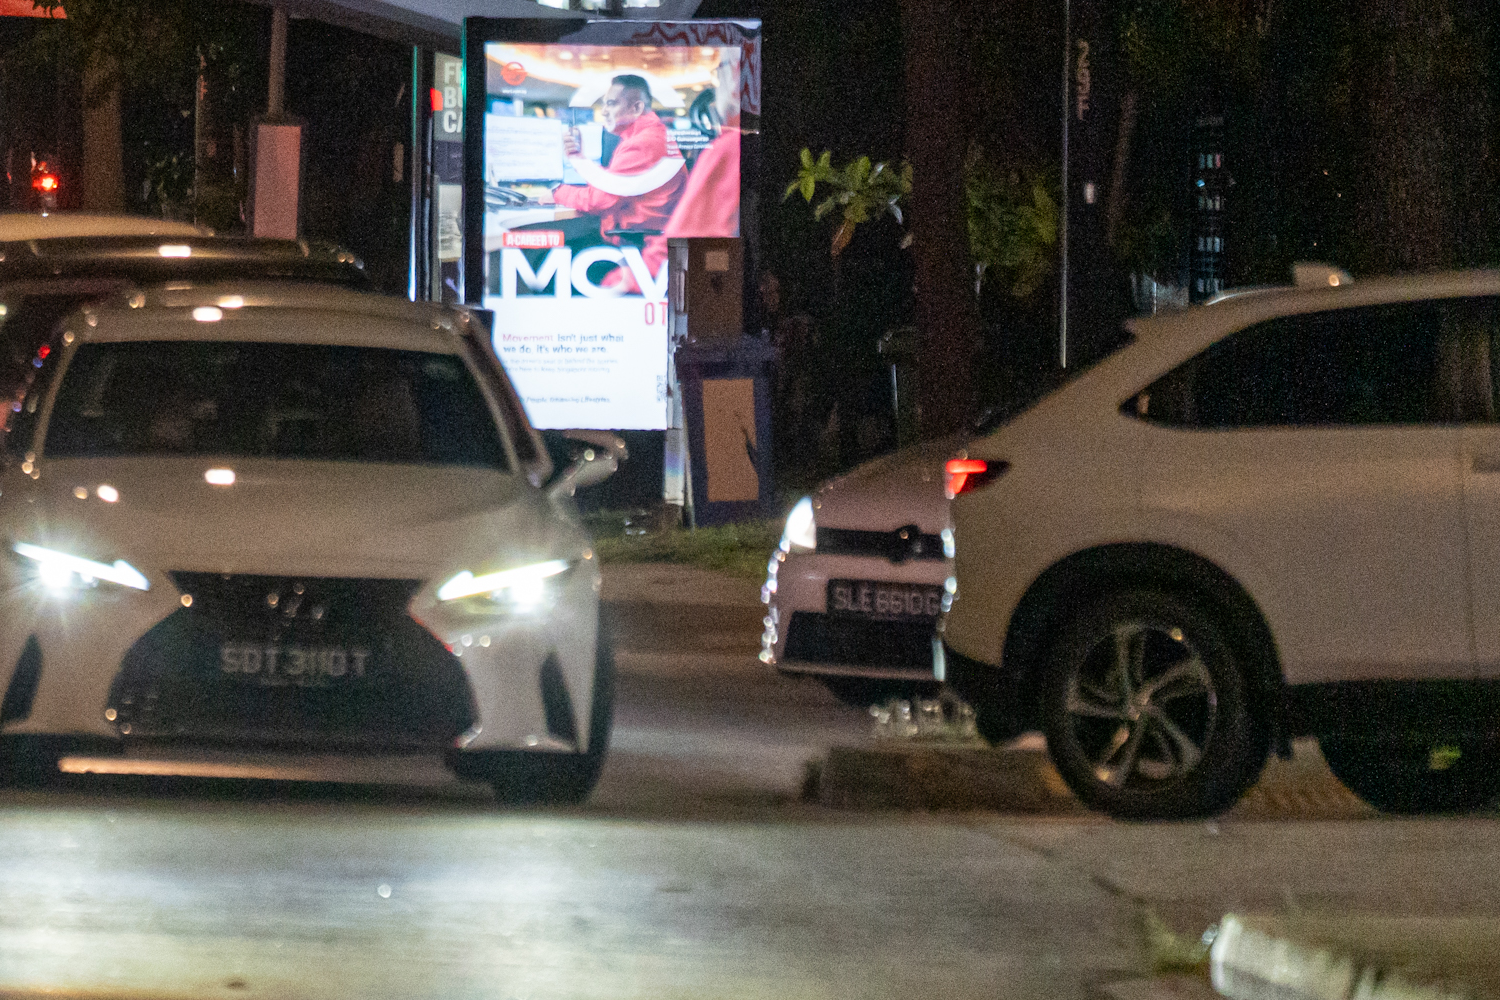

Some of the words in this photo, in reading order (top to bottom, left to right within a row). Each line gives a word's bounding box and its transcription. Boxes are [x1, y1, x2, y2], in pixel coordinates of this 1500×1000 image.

[515, 234, 547, 246] CAREER
[548, 234, 560, 246] TO
[502, 333, 553, 343] Movement
[579, 333, 598, 344] just
[601, 333, 624, 342] what
[552, 344, 573, 354] who
[575, 346, 589, 354] we
